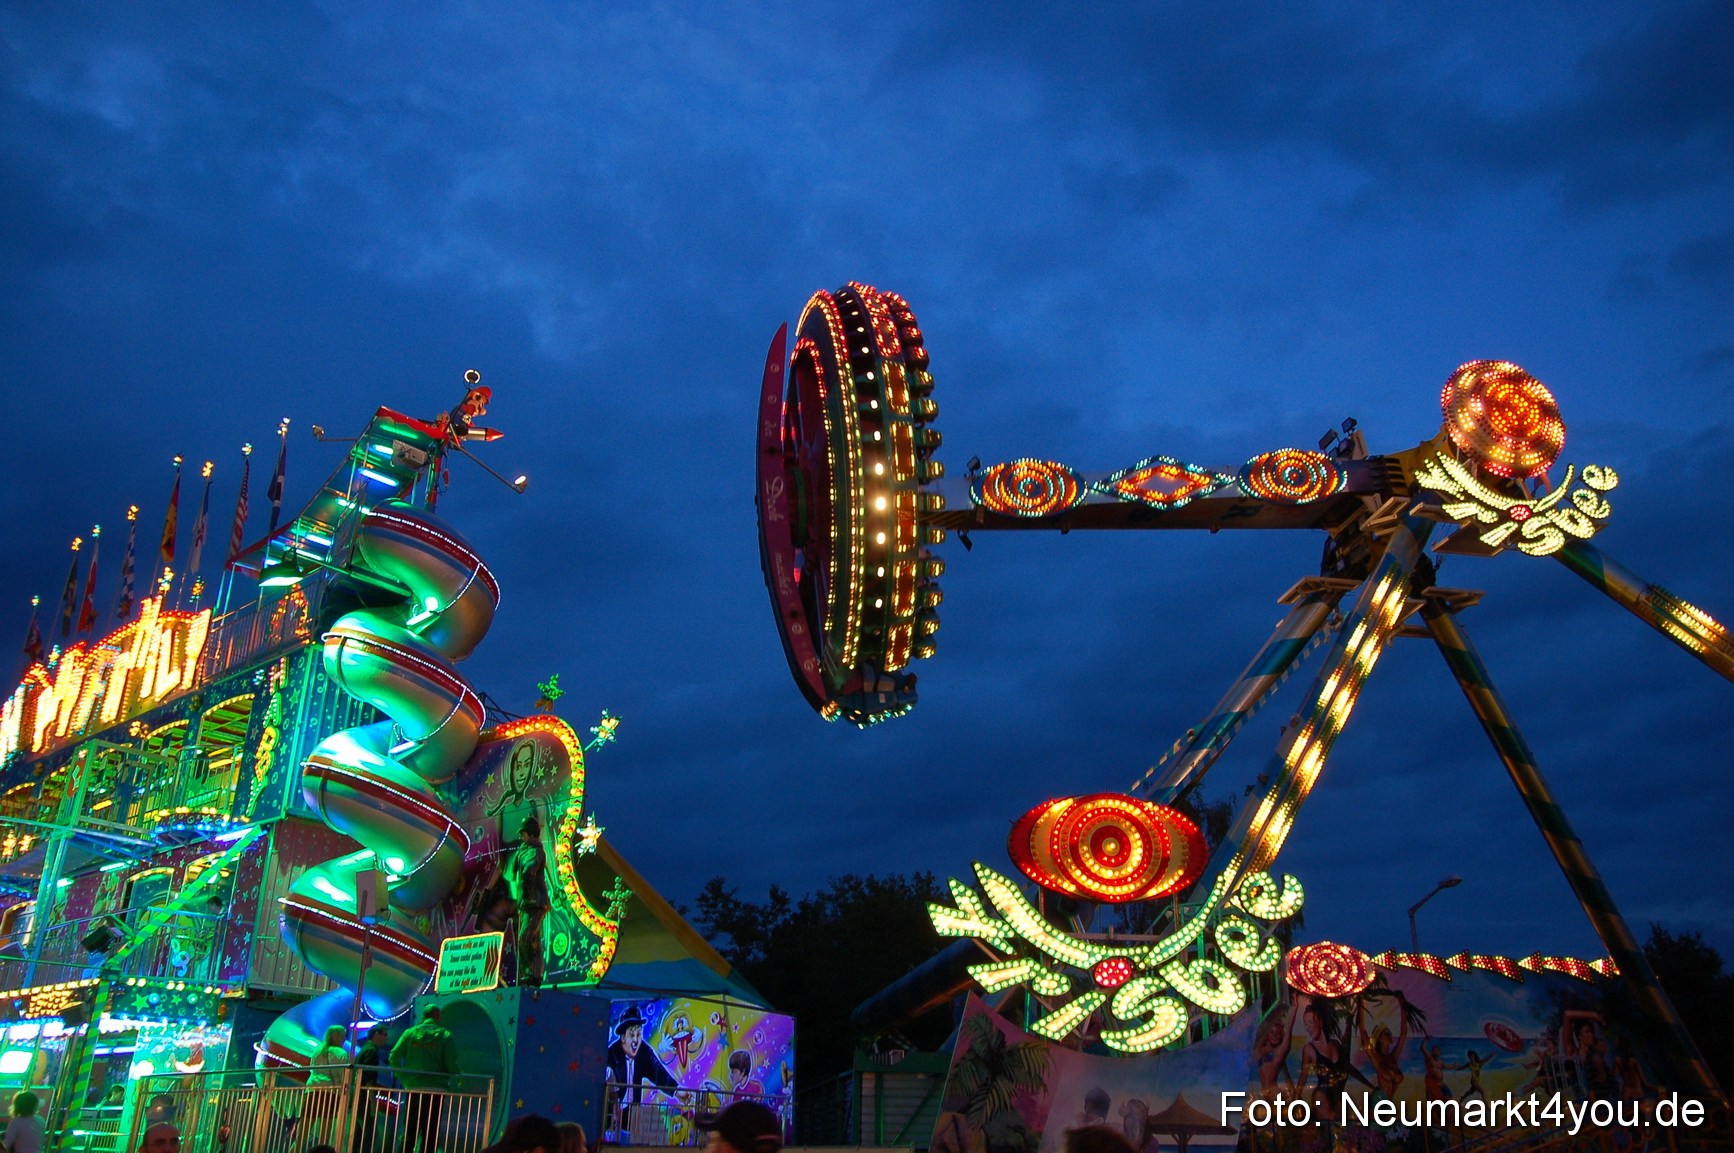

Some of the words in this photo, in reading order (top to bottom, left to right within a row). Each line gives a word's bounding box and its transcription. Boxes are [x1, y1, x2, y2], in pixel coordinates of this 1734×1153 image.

[1414, 450, 1620, 557] Frisbee
[246, 655, 289, 818] HAPPY
[926, 859, 1305, 1053] Frisbee
